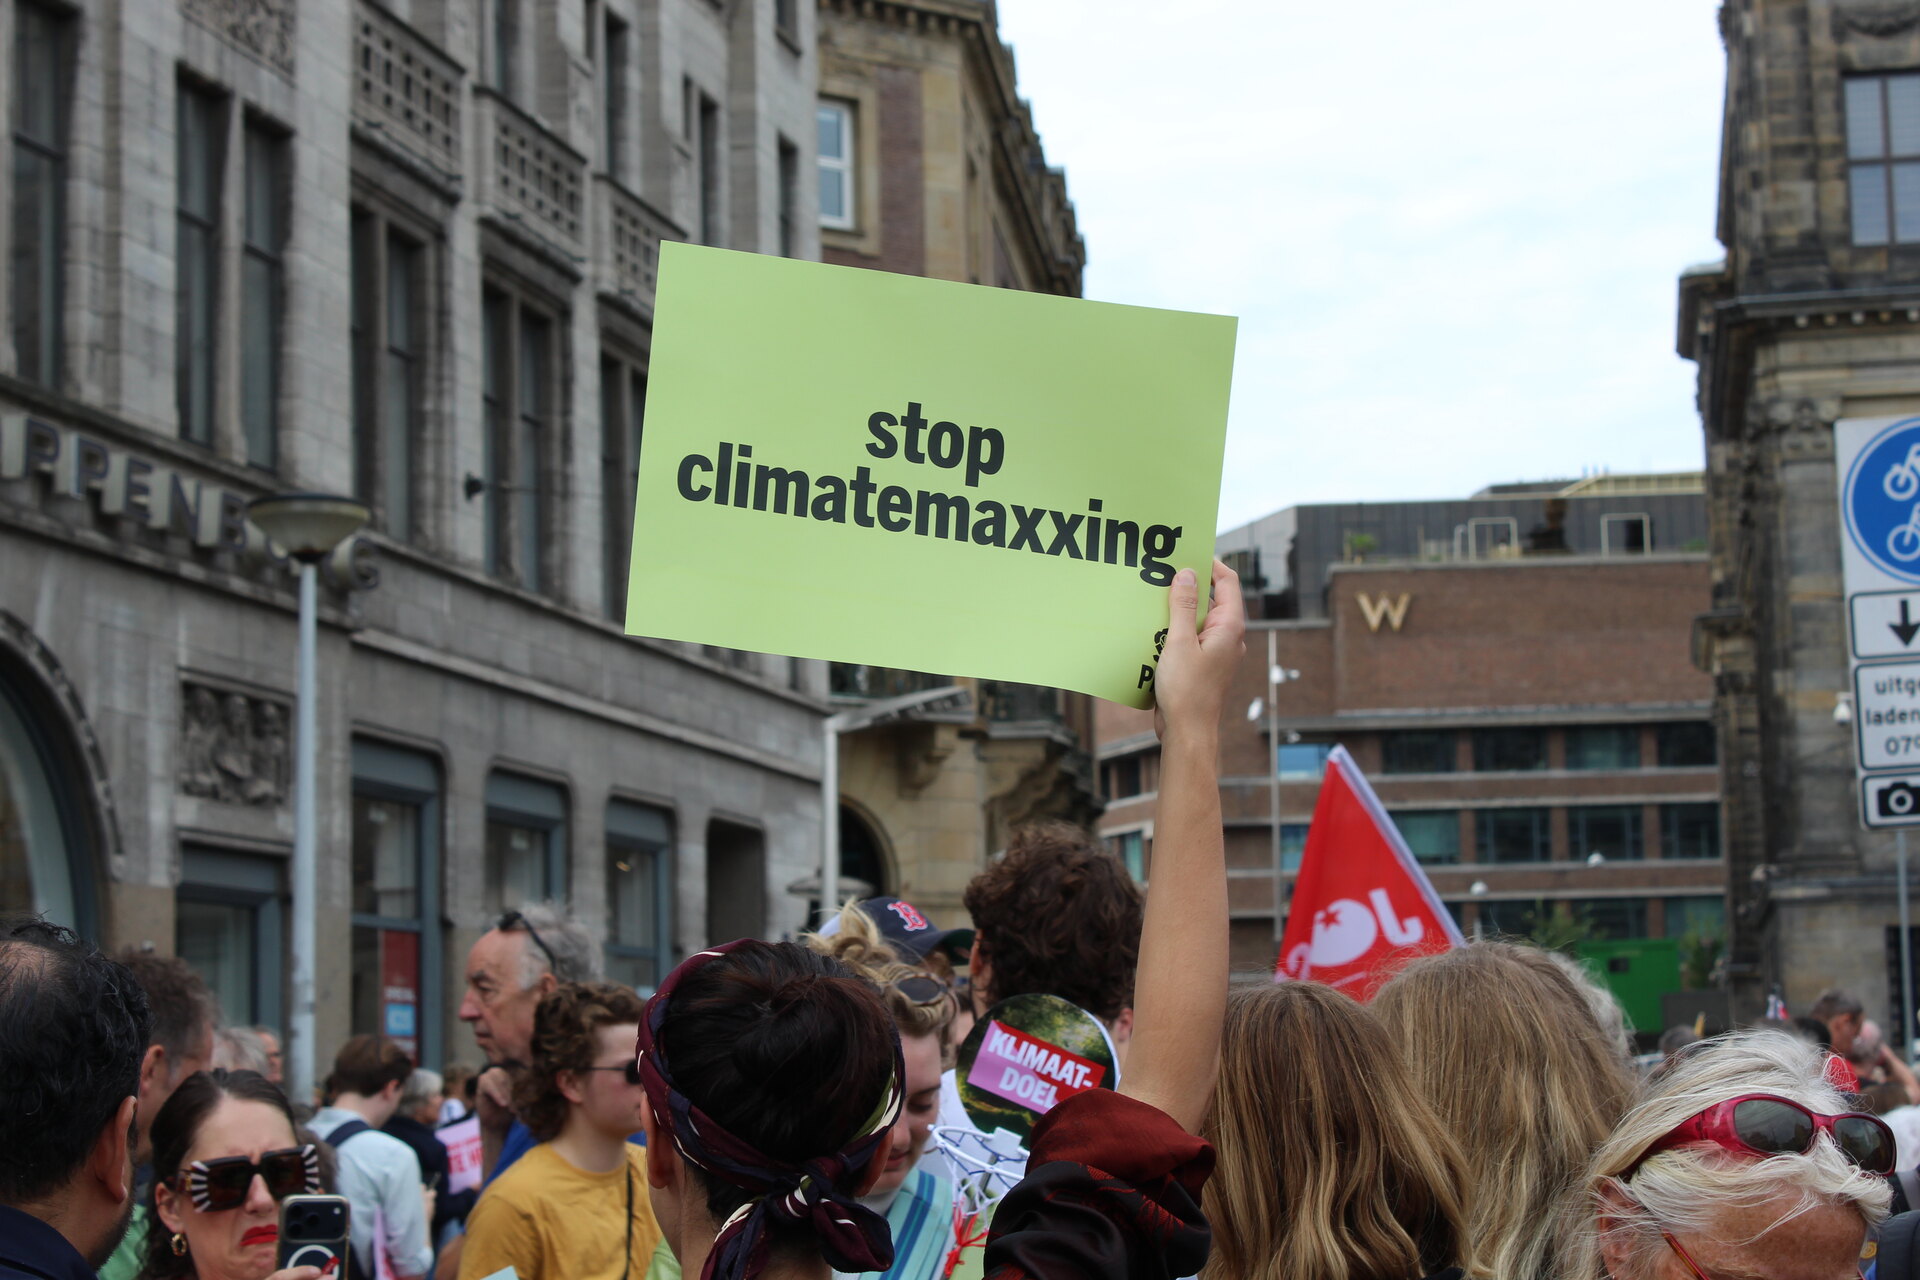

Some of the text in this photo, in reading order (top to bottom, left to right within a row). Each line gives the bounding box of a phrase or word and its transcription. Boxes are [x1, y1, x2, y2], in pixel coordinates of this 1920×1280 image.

[865, 401, 1005, 487] stop
[677, 441, 1182, 587] climatemaxxing
[1356, 591, 1411, 633] W
[1874, 674, 1920, 698] uitg
[887, 901, 928, 932] B
[986, 1029, 1093, 1089] KLIMAAT-
